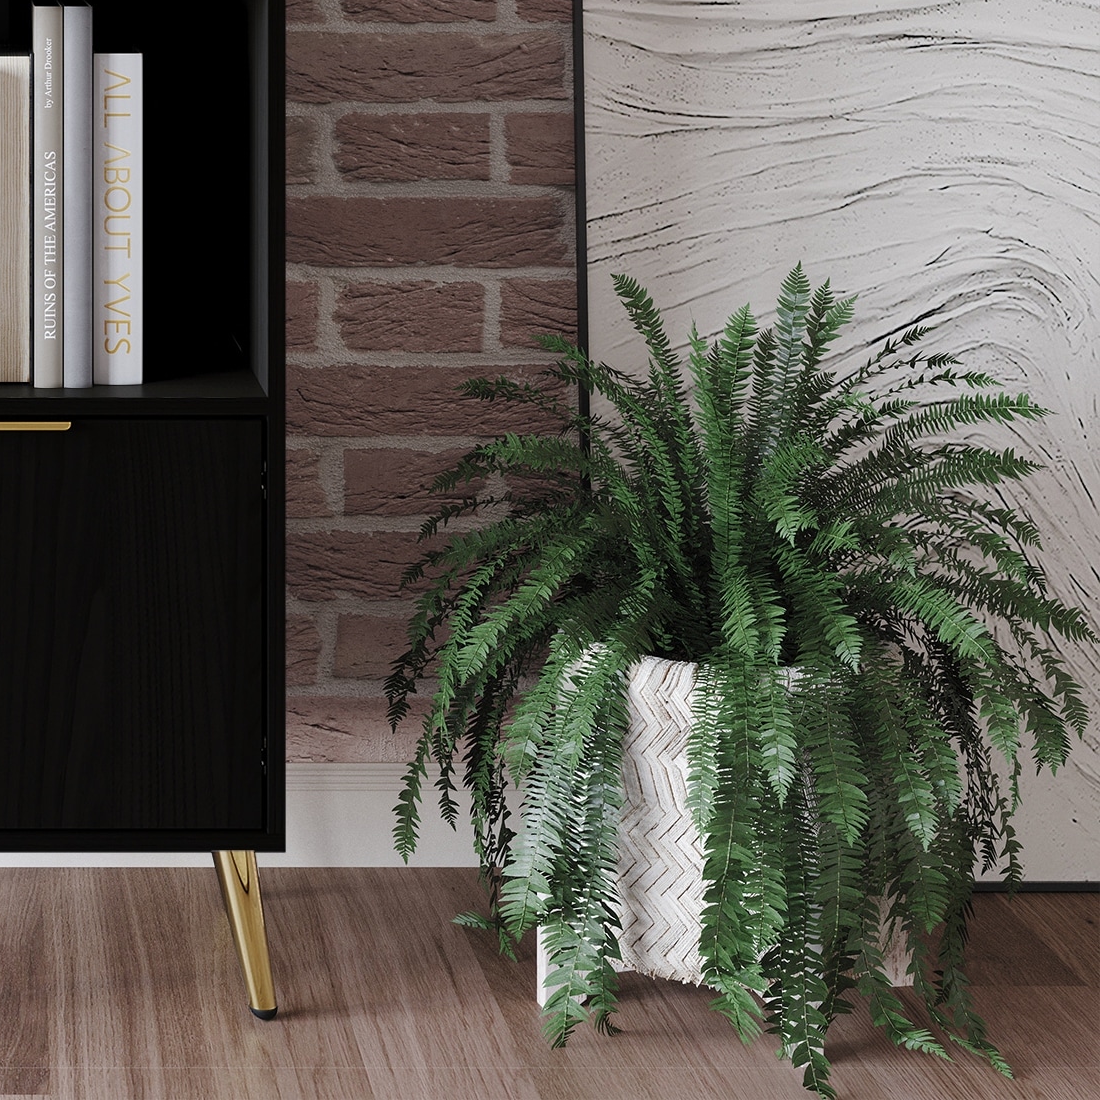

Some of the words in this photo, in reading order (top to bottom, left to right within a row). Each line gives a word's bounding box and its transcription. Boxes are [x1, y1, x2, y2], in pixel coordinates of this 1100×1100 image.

[45, 98, 54, 109] by
[104, 68, 132, 129] ALL
[44, 151, 57, 232] AMERICAS
[104, 141, 132, 259] ABOUT
[44, 234, 56, 266] THE
[44, 269, 56, 290] OF
[44, 292, 56, 340] RUINS
[104, 272, 132, 355] YVES
